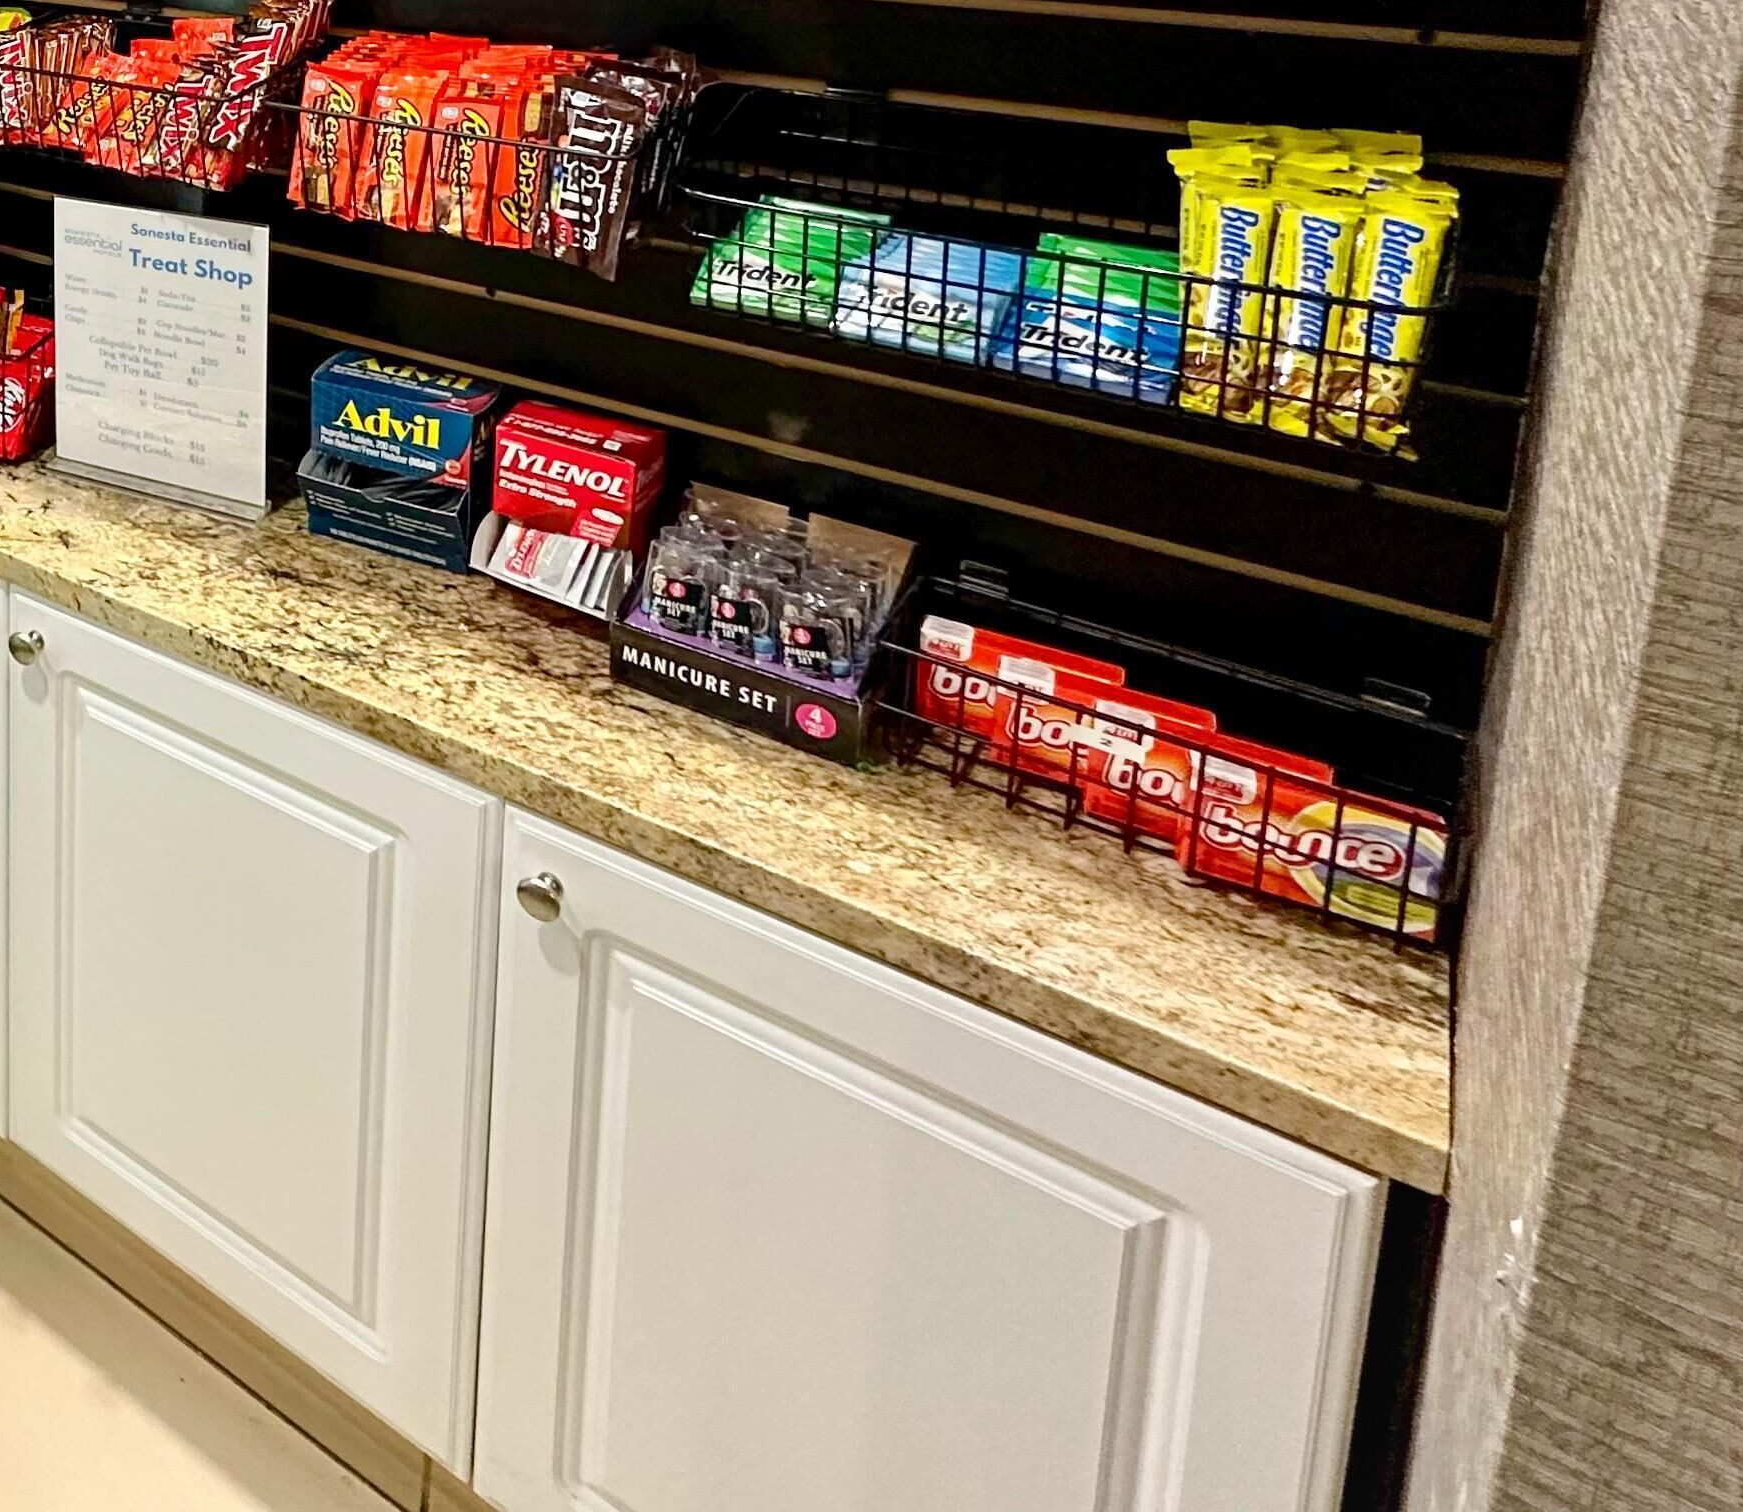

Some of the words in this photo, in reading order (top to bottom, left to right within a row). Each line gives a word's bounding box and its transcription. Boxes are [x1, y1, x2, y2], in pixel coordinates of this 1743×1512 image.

[499, 140, 540, 233] Reese
[607, 153, 629, 215] hocolate
[64, 234, 122, 251] essential
[130, 223, 185, 244] Sonesta
[189, 232, 252, 254] Essential
[129, 248, 187, 275] Treat
[194, 259, 253, 289] Shop
[713, 256, 817, 290] Trident
[859, 285, 968, 323] Trident
[99, 348, 116, 361] Dog
[1021, 322, 1150, 364] Trident
[104, 360, 119, 372] Pet
[121, 364, 140, 377] Toy
[343, 357, 473, 391] Advil
[332, 399, 440, 450] Advil
[499, 439, 625, 498] TYLENOL
[499, 478, 528, 494] Extra
[528, 488, 577, 508] Strength
[654, 595, 697, 614] MANICURE
[666, 606, 683, 618] SET
[785, 644, 828, 661] MANICURE
[796, 653, 814, 666] SET
[622, 645, 732, 698] MANICURE
[738, 685, 778, 714] SET
[809, 707, 822, 721] 4
